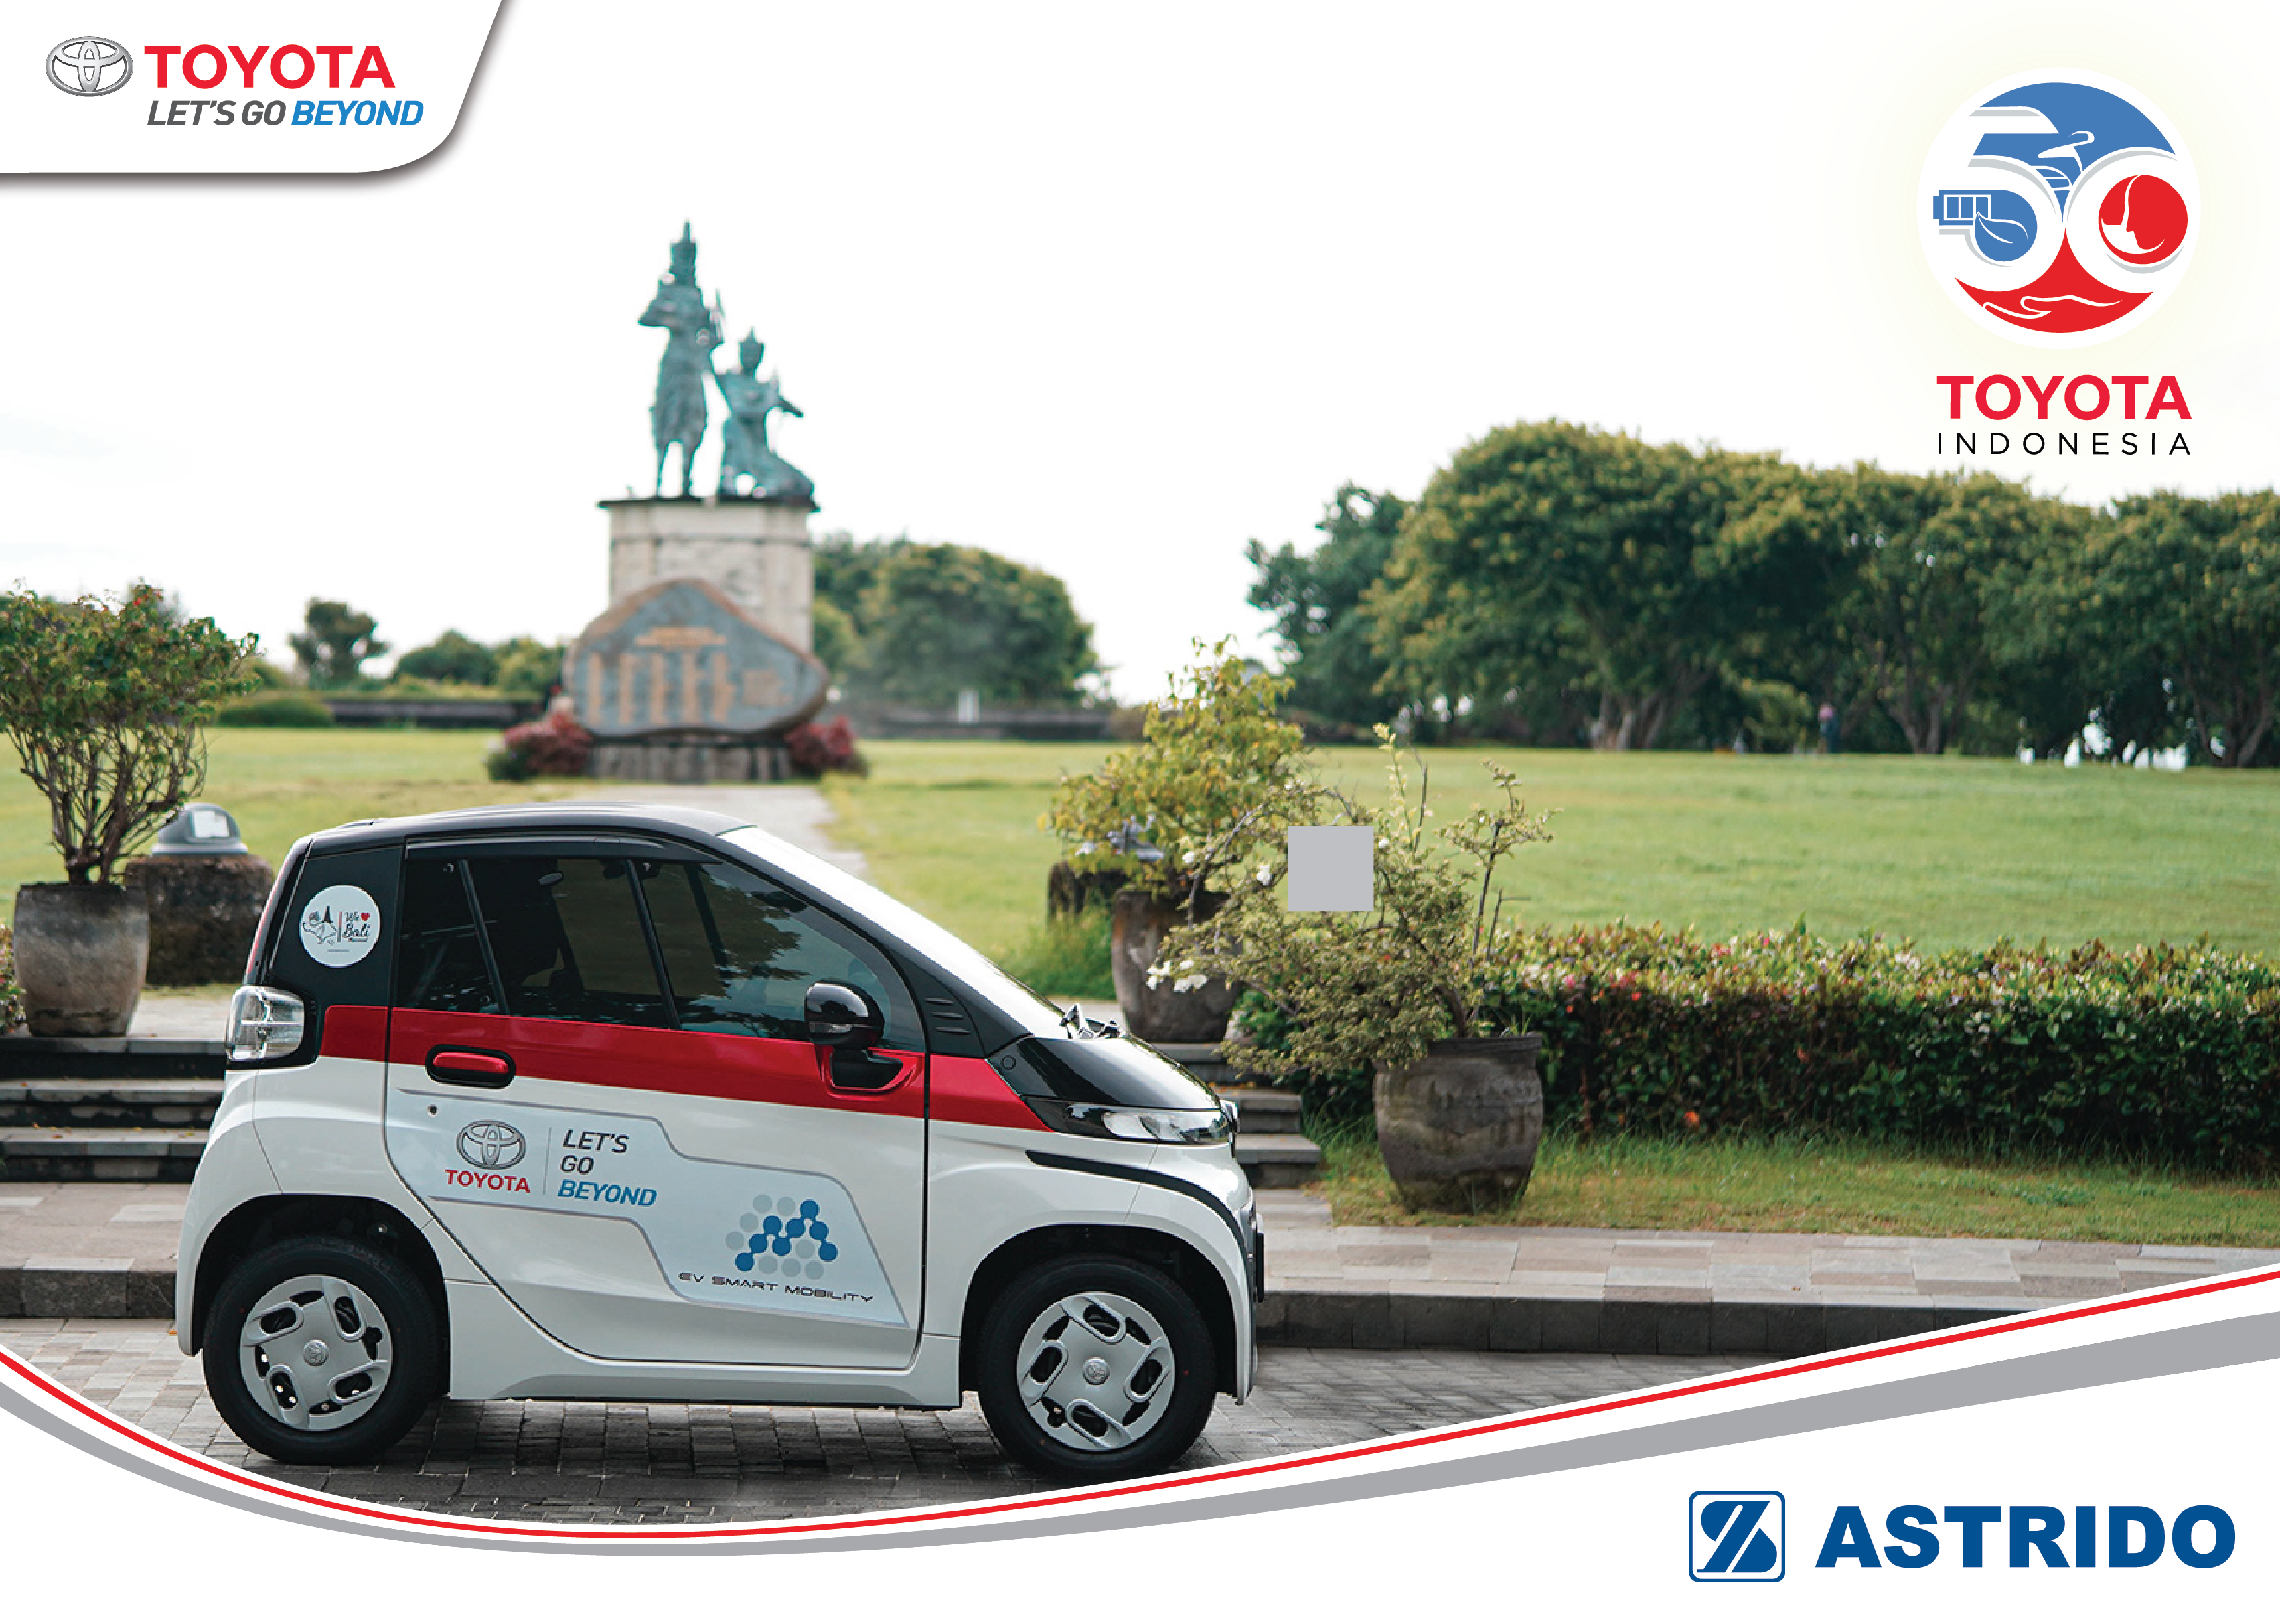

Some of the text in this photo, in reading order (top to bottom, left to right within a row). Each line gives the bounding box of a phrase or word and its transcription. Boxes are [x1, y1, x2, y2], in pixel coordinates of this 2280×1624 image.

[344, 911, 360, 922] We
[342, 923, 370, 939] Bali
[562, 1129, 629, 1153] LET'S
[560, 1155, 594, 1175] GO
[445, 1169, 530, 1193] TOYOTA
[558, 1179, 658, 1206] BEYOND
[678, 1272, 873, 1303] EV SMART MOBILITY
